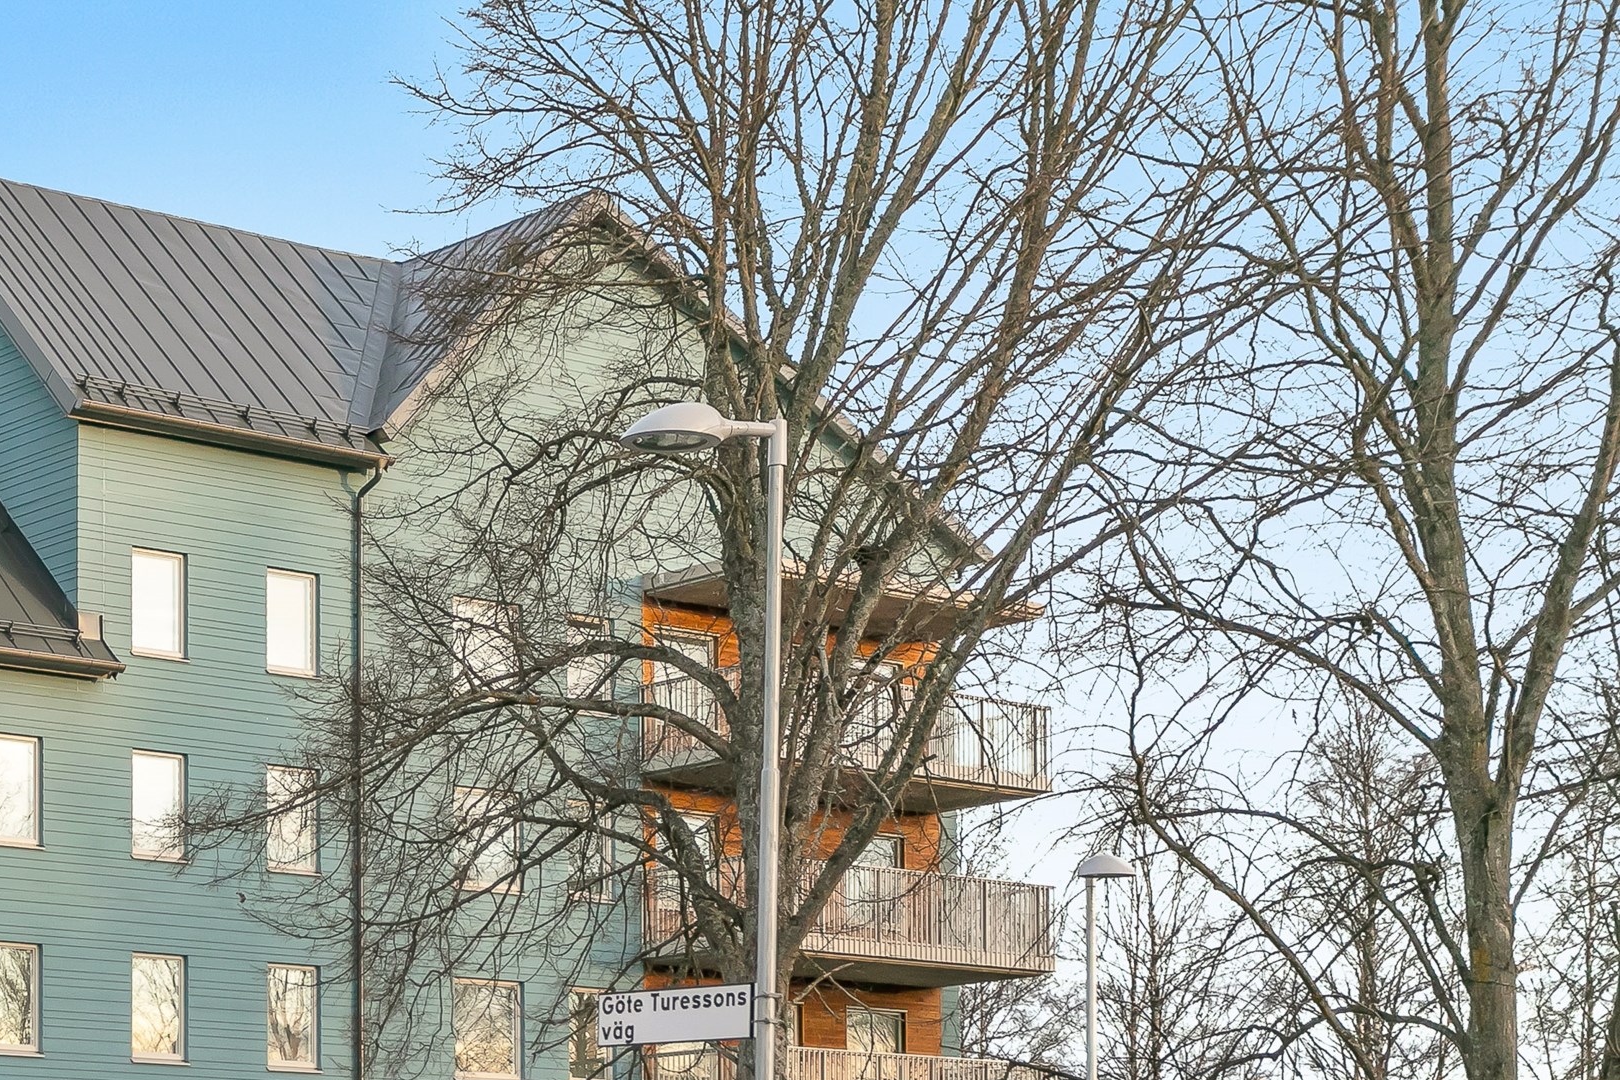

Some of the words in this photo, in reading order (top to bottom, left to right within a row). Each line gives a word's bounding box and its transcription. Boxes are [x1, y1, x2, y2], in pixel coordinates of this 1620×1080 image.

[603, 995, 644, 1015] Göte
[650, 990, 747, 1012] Turessons
[602, 1021, 635, 1044] väg
